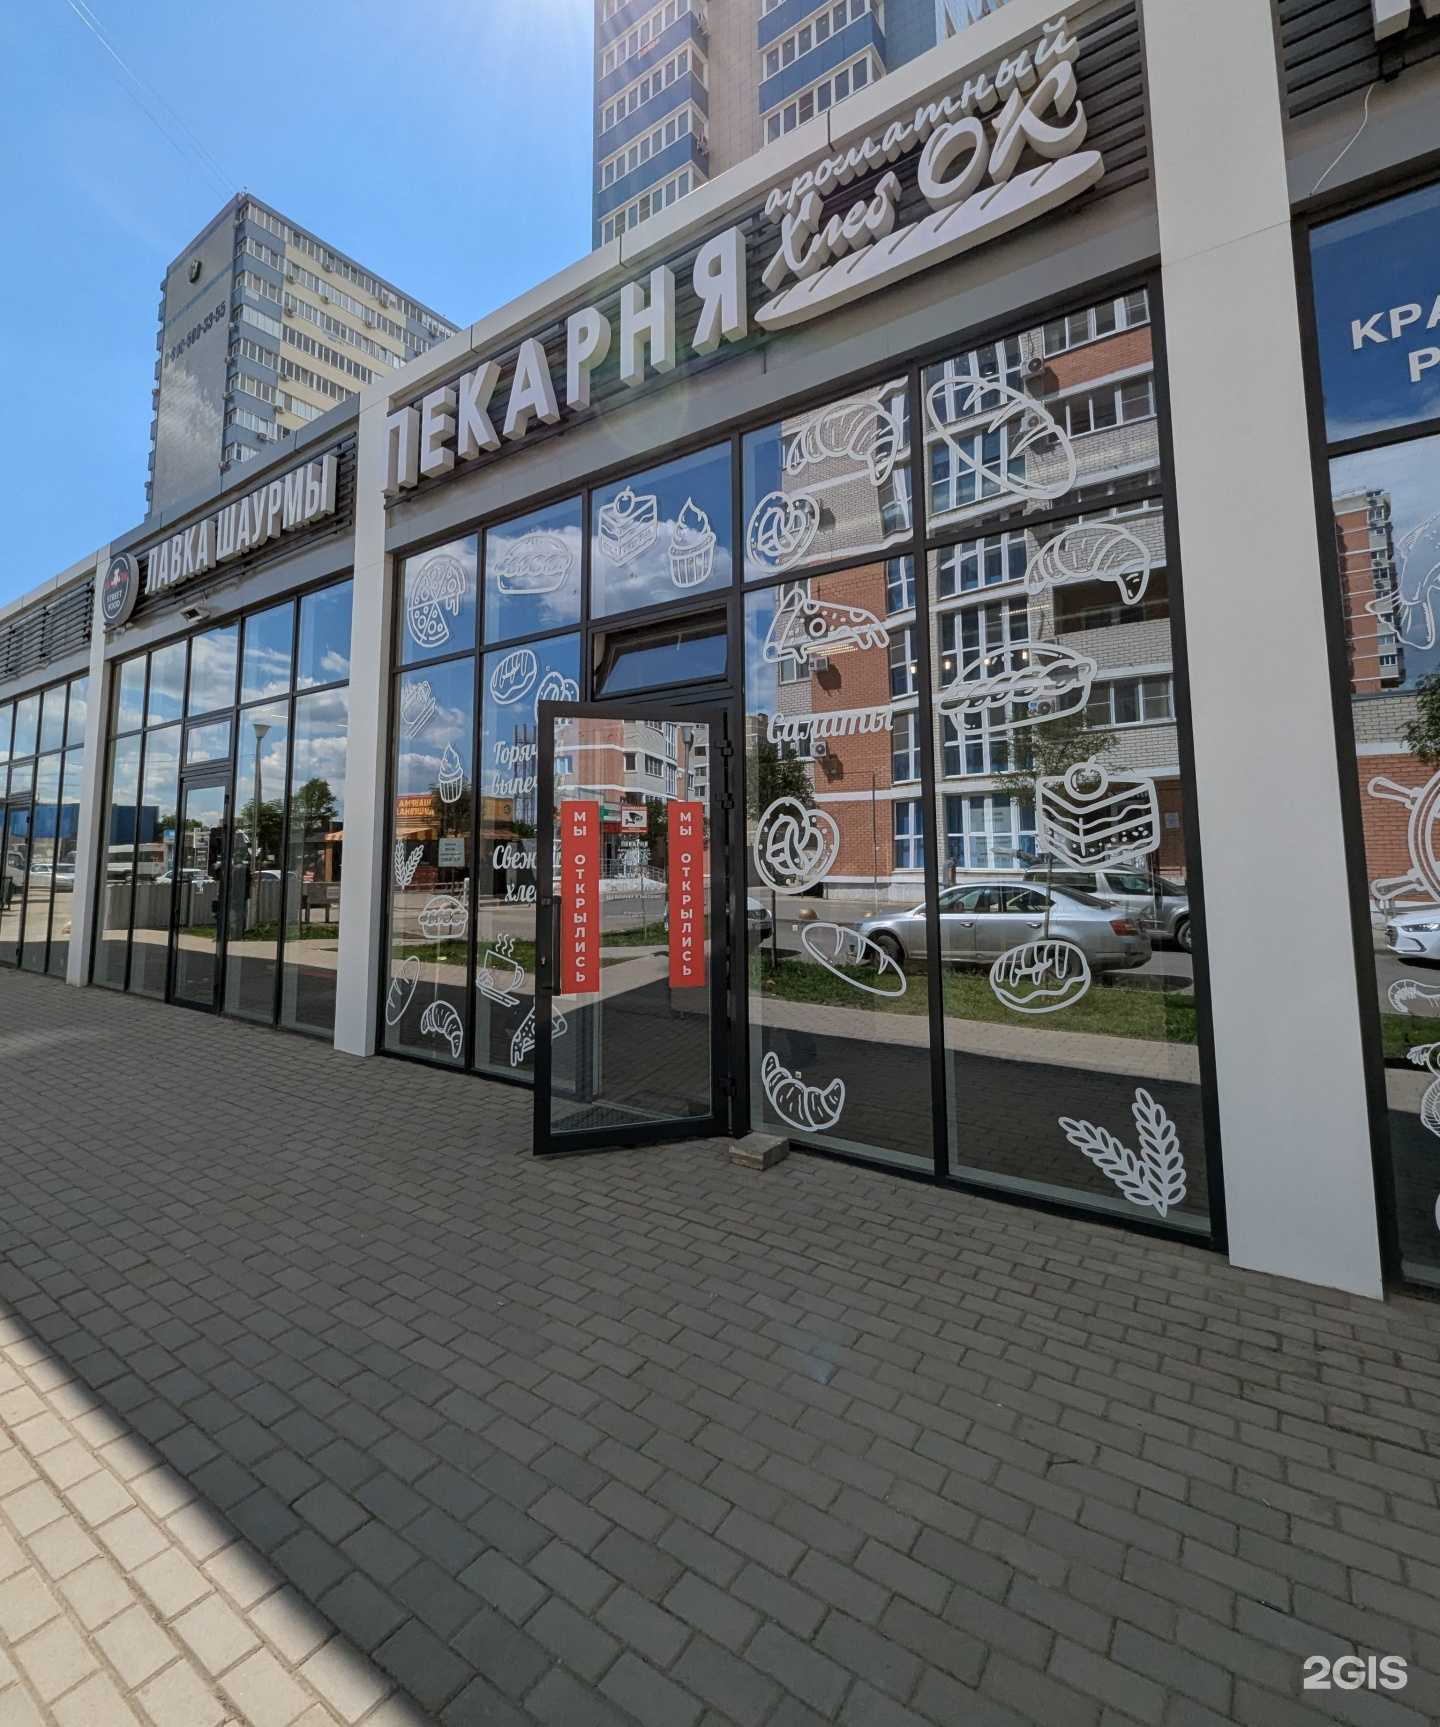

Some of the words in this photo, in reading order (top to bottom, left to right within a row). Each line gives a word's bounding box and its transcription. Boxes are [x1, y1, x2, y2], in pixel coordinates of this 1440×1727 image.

[765, 17, 1080, 222] ароматный
[385, 226, 747, 495] ПЕКАРНЯ
[145, 518, 216, 595] ЛАВКА
[216, 455, 337, 560] ШАУРМЫ
[491, 771, 537, 795] выпе
[573, 812, 587, 836] МЫ
[680, 812, 692, 836] МЫ
[573, 854, 587, 982] ОТКРЫЛИСЬ
[680, 853, 693, 976] ОТКРЫЛИСЬ
